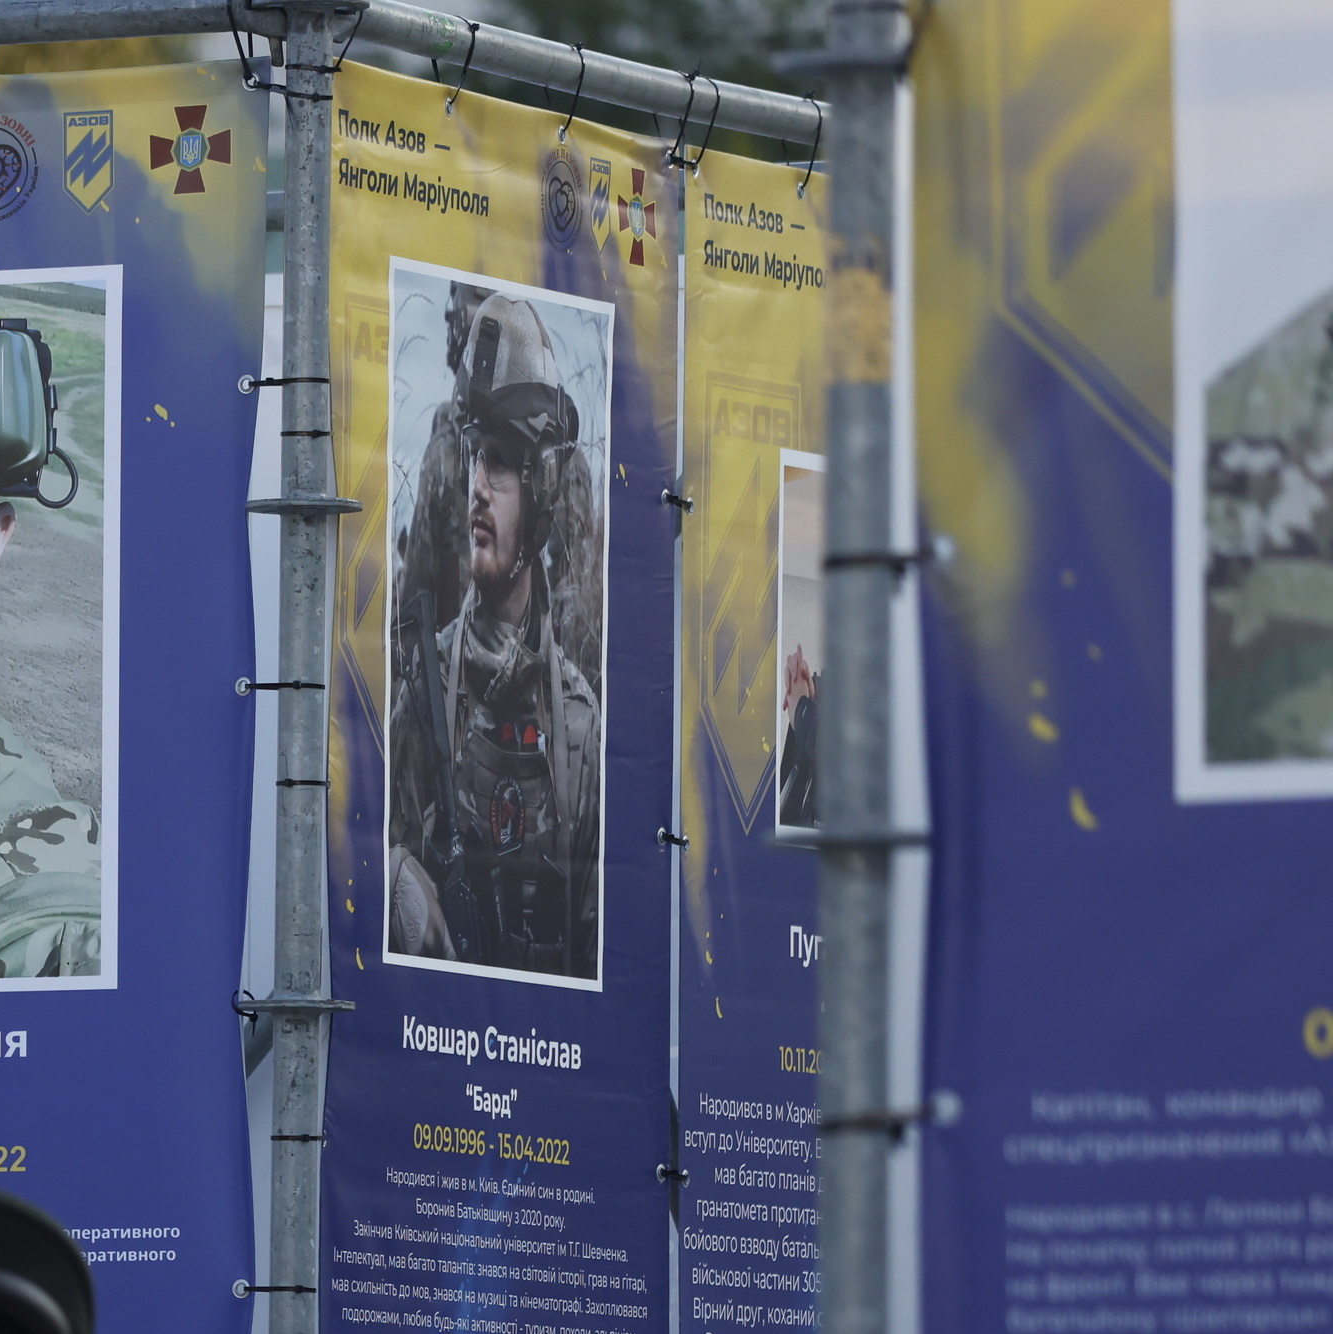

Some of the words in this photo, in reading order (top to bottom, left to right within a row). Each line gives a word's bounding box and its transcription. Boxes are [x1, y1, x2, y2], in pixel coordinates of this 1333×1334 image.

[68, 116, 109, 127] АЗОВ
[339, 109, 380, 144] Полк
[385, 121, 425, 153] Азов
[339, 158, 398, 197] Янголи
[404, 172, 488, 217] Маріуполя
[705, 193, 743, 226] Полк
[748, 203, 783, 233] Азов
[704, 240, 759, 275] Янголи
[765, 252, 825, 291] Маріупо
[789, 925, 822, 967] Пуг
[403, 1017, 479, 1065] Ковшар
[485, 1026, 581, 1069] Станіслав
[700, 1093, 762, 1120] Народився
[414, 1123, 485, 1156] 09.09.1996
[498, 1133, 569, 1165] 15.04.2022
[685, 1131, 715, 1153] вступ
[718, 1134, 733, 1153] до
[735, 1131, 812, 1163] Університету.
[387, 1167, 435, 1187] Народився
[441, 1177, 459, 1190] жив
[462, 1179, 466, 1190] в
[480, 1177, 500, 1194] Київ.
[502, 1179, 535, 1197] Єдиний
[538, 1187, 554, 1199] син
[556, 1189, 561, 1200] в
[564, 1188, 595, 1204] родині.
[715, 1167, 736, 1185] мав
[739, 1164, 776, 1188] багато
[779, 1169, 815, 1191] планів
[416, 1198, 455, 1218] Боронив
[457, 1203, 512, 1227] Батьківщину
[521, 1209, 542, 1226] 2020
[544, 1215, 566, 1232] року.
[697, 1200, 768, 1221] гранатомета
[81, 1250, 176, 1266] еративного
[354, 1220, 392, 1239] Закінчив
[395, 1225, 438, 1243] Київський
[441, 1230, 501, 1249] національний
[504, 1239, 555, 1256] університет
[558, 1244, 566, 1256] ім
[582, 1243, 628, 1262] Шевченка.
[684, 1228, 737, 1253] бойового
[741, 1238, 779, 1261] взводу
[692, 1261, 750, 1287] військової
[753, 1273, 799, 1291] частини
[694, 1297, 733, 1324] Вірний
[736, 1305, 765, 1327] друг,
